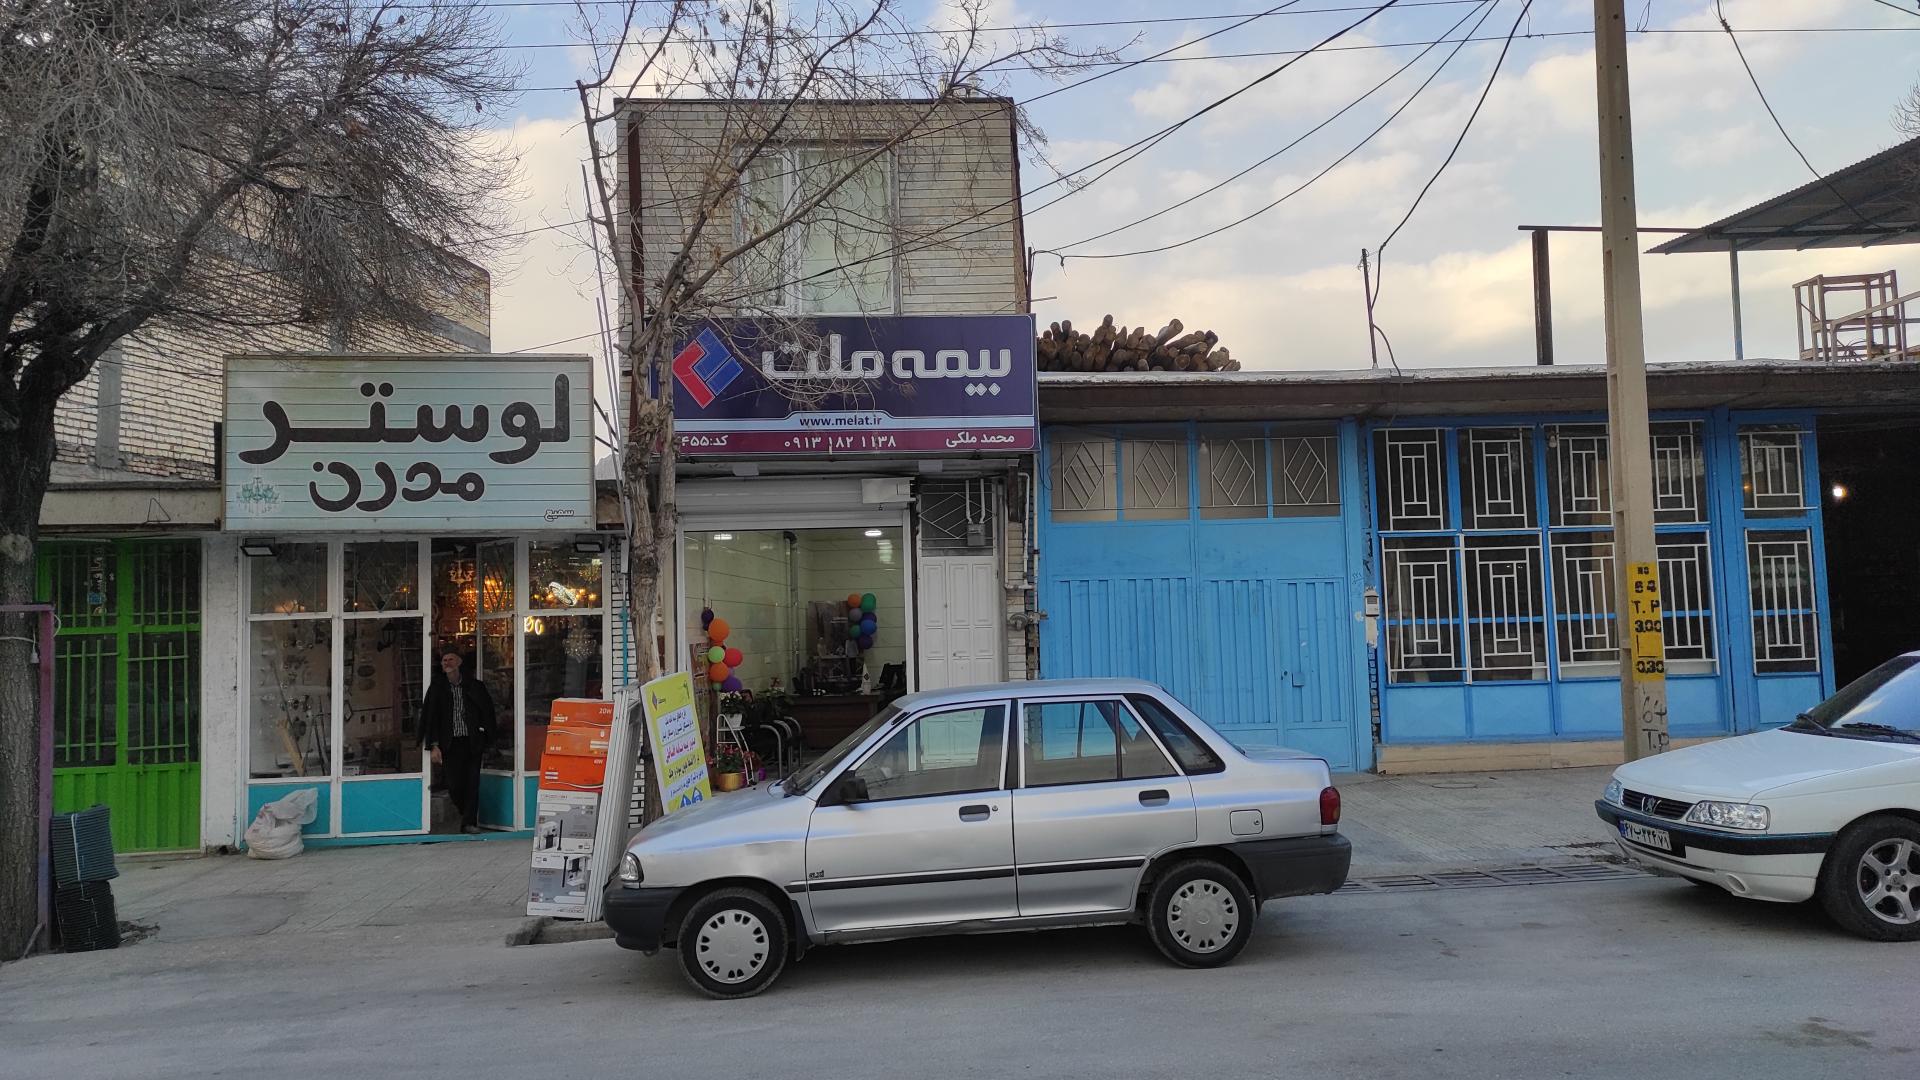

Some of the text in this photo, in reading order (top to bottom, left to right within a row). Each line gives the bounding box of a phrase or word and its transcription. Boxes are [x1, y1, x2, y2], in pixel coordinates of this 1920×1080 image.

[762, 333, 1012, 397] بیمه ملت
[238, 373, 570, 465] لوستر
[799, 415, 883, 427] www.melat.ir
[784, 435, 897, 449] ۰۹۱۳ ۱۸۲ ۱۱۳۸
[945, 431, 1015, 448] محمد ملکی
[309, 461, 485, 513] مدرن
